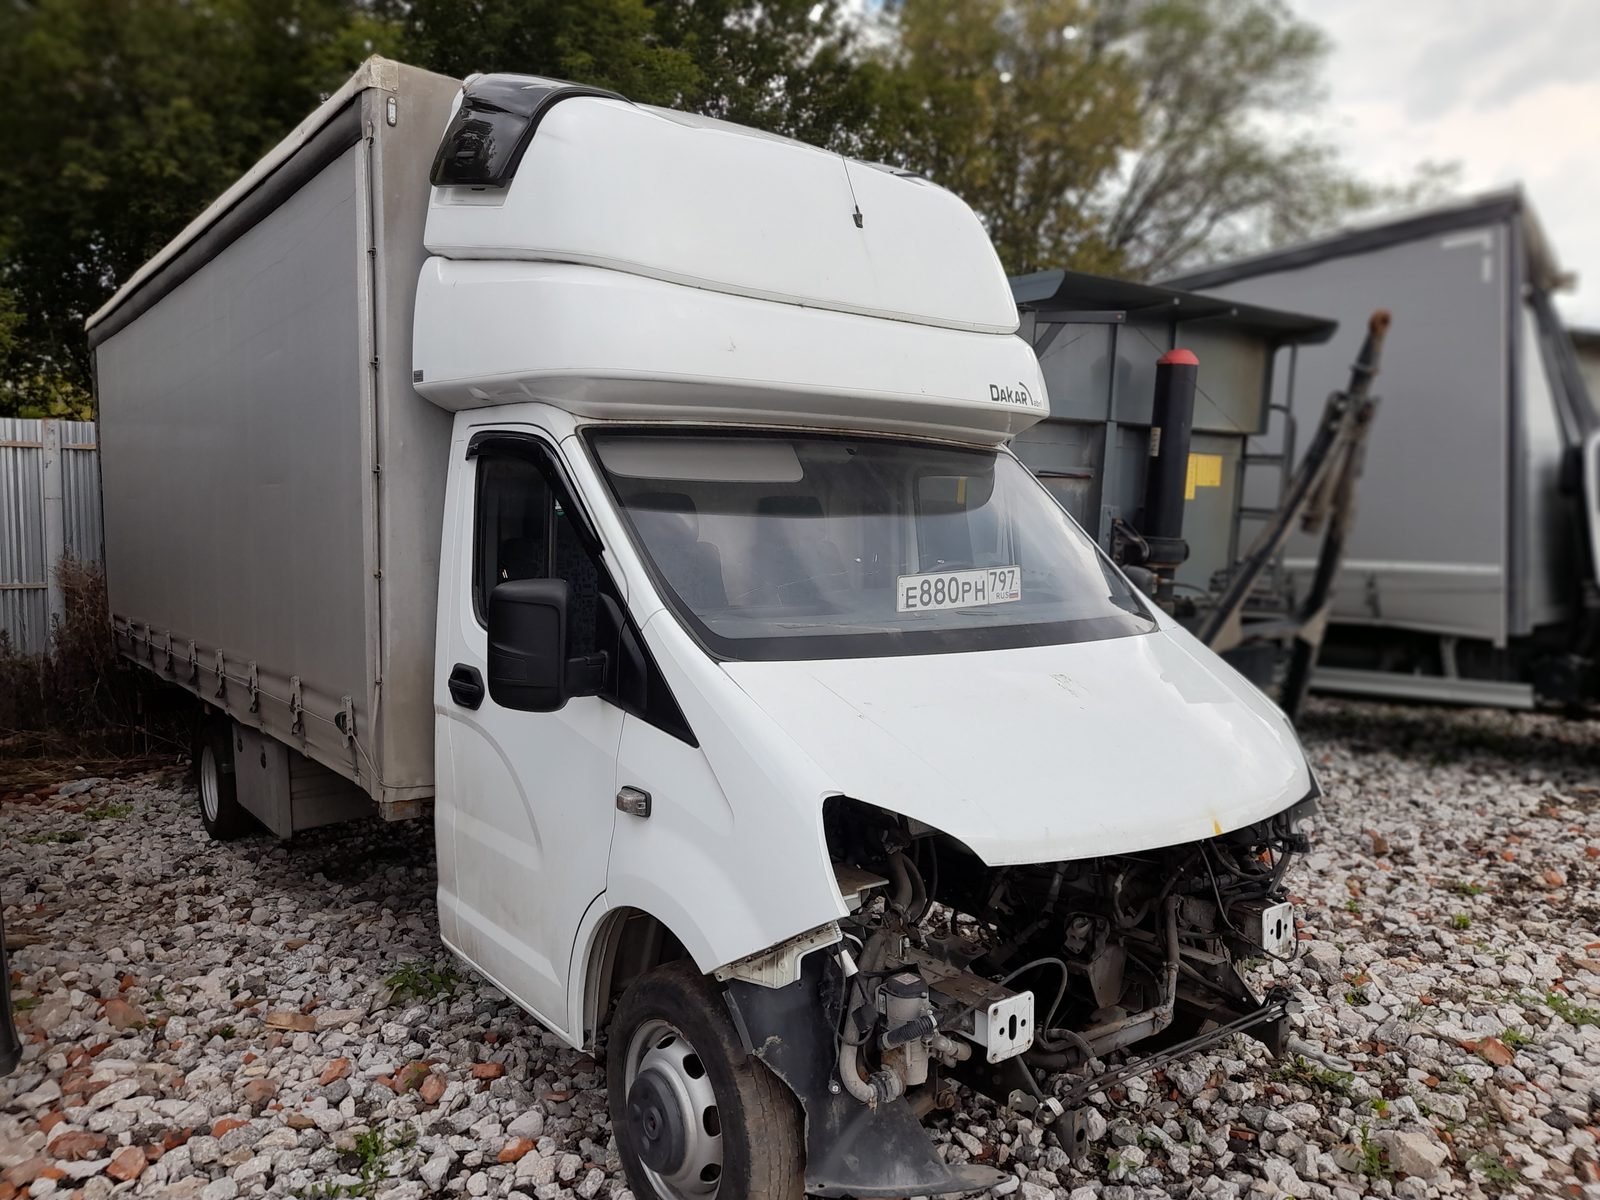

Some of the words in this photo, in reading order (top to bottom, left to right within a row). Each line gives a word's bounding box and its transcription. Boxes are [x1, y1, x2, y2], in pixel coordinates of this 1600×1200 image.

[989, 384, 1028, 406] DAKAR
[989, 570, 1015, 593] 797
[996, 591, 1009, 600] RUS
